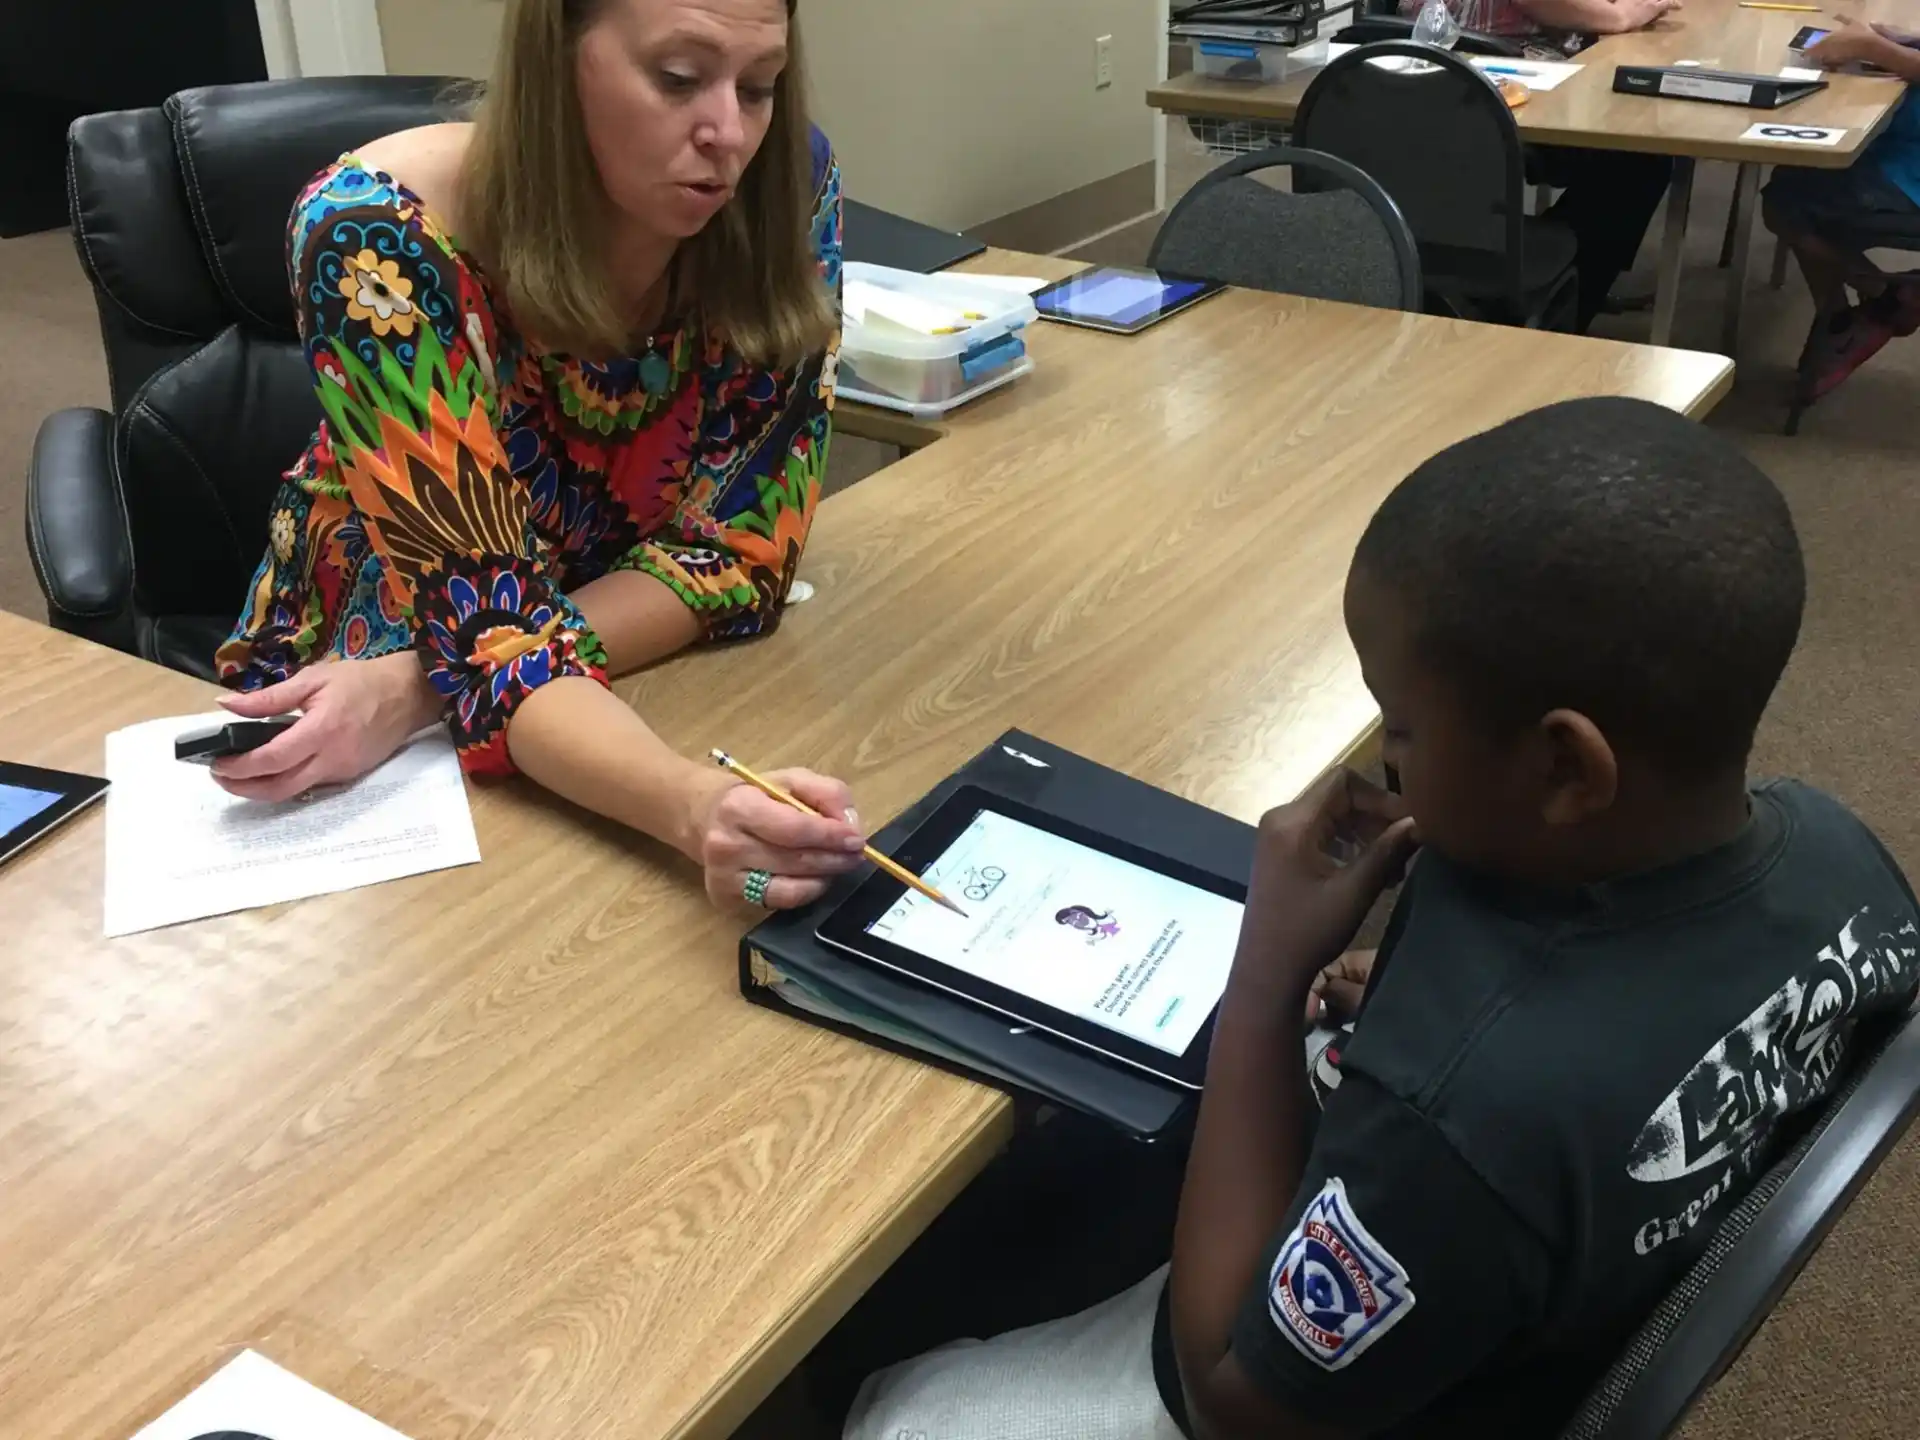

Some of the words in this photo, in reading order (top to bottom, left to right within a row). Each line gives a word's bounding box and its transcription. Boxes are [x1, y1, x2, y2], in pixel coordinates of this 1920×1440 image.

[1093, 995, 1108, 1009] Play
[1104, 983, 1117, 994] this
[1104, 991, 1124, 1013] Choose
[1131, 958, 1149, 980] correct
[1146, 935, 1167, 959] spelling
[1117, 1000, 1132, 1017] word
[1134, 966, 1157, 994] complete
[1633, 1167, 1735, 1256] Great
[1310, 1225, 1340, 1251] LITTLE
[1338, 1251, 1376, 1308] LEAGUE
[1280, 1284, 1332, 1347] BASEBALL
